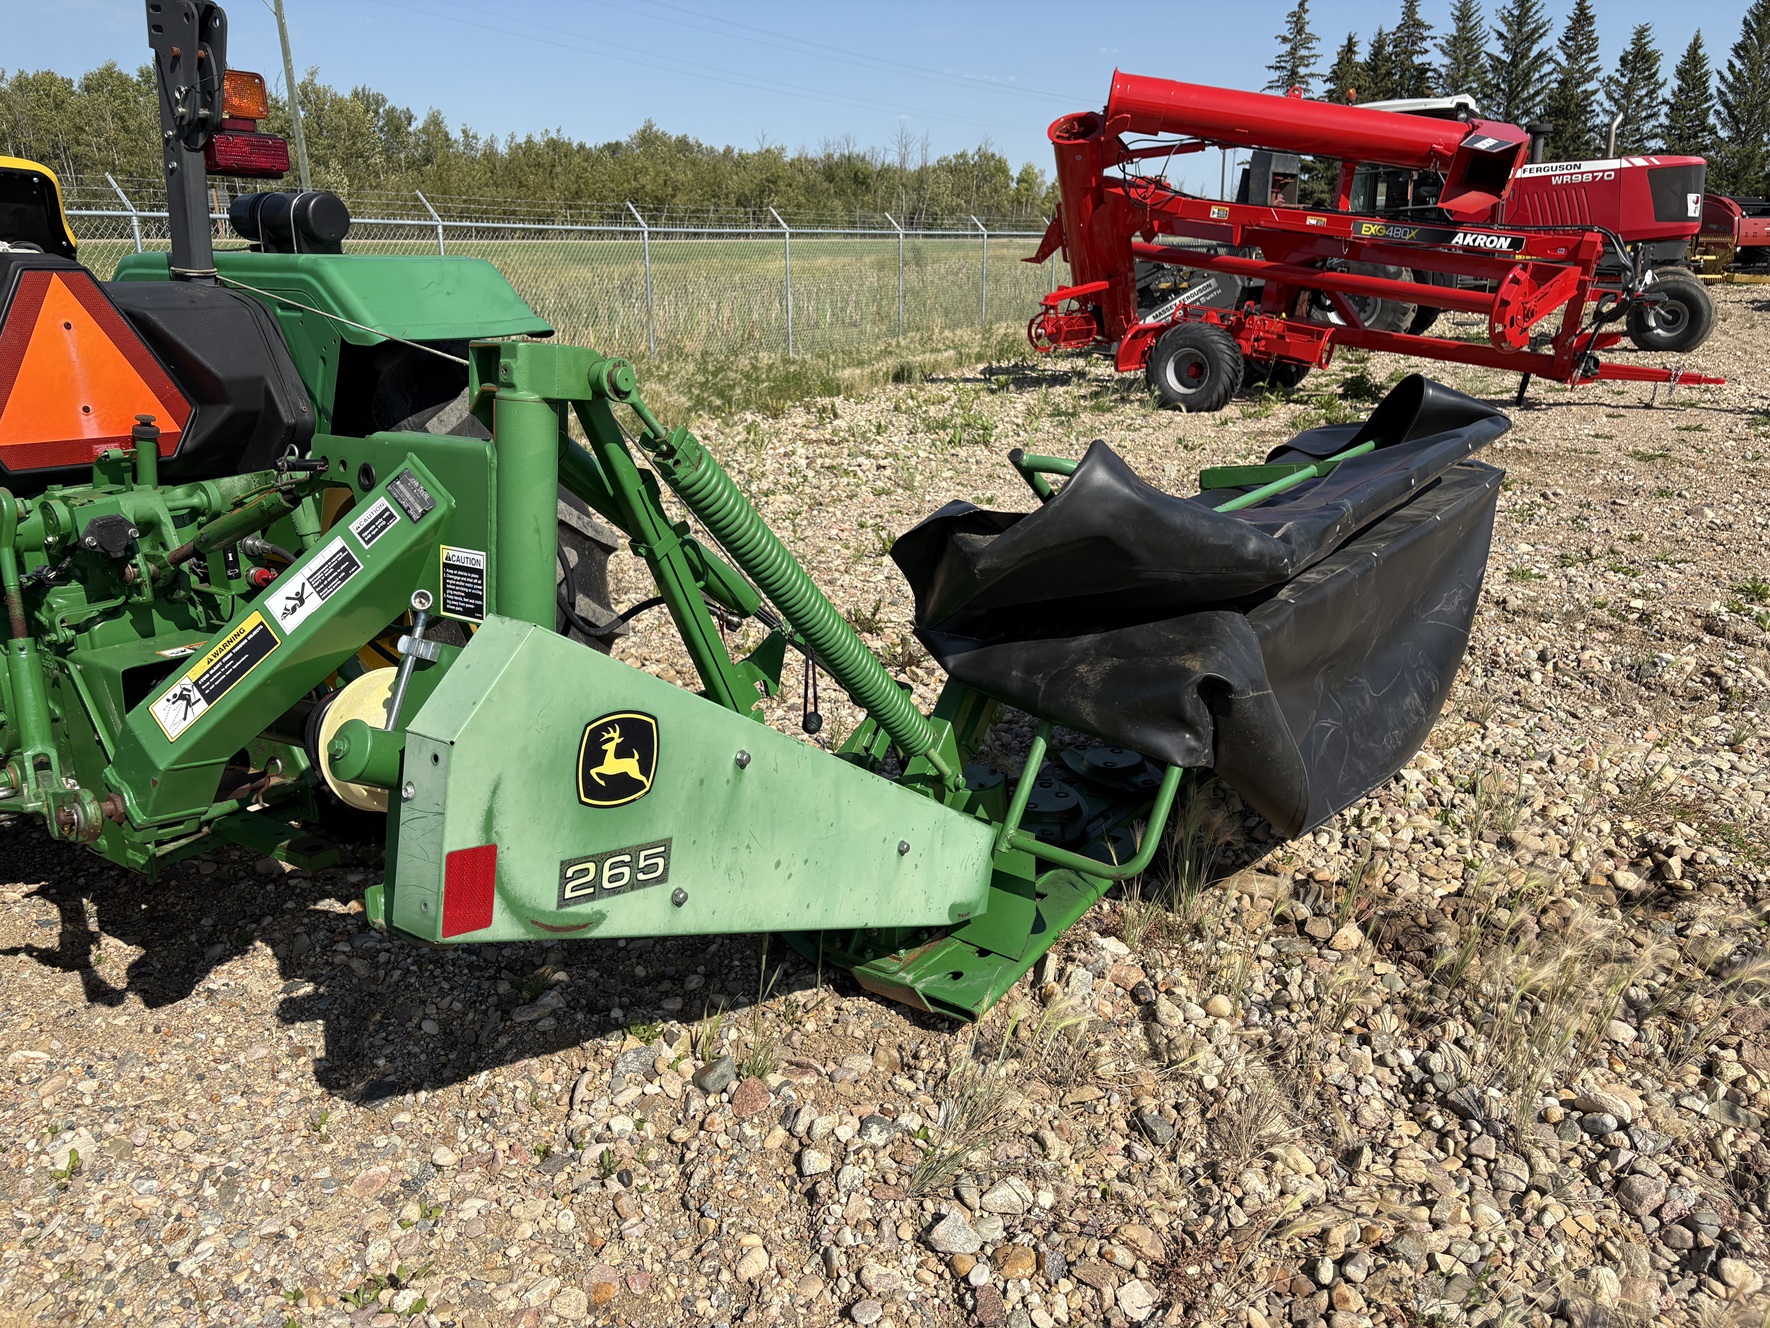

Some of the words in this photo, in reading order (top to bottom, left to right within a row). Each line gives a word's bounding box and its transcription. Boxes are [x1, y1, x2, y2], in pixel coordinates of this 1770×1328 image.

[1522, 163, 1582, 175] FERGUSON
[1551, 171, 1615, 185] WR9870
[1451, 232, 1512, 250] AKRON
[1152, 302, 1177, 321] MASSEY
[358, 501, 385, 526] CAUTION
[451, 553, 482, 567] CAUTION
[211, 626, 246, 658] WARNING
[563, 845, 667, 901] 265
